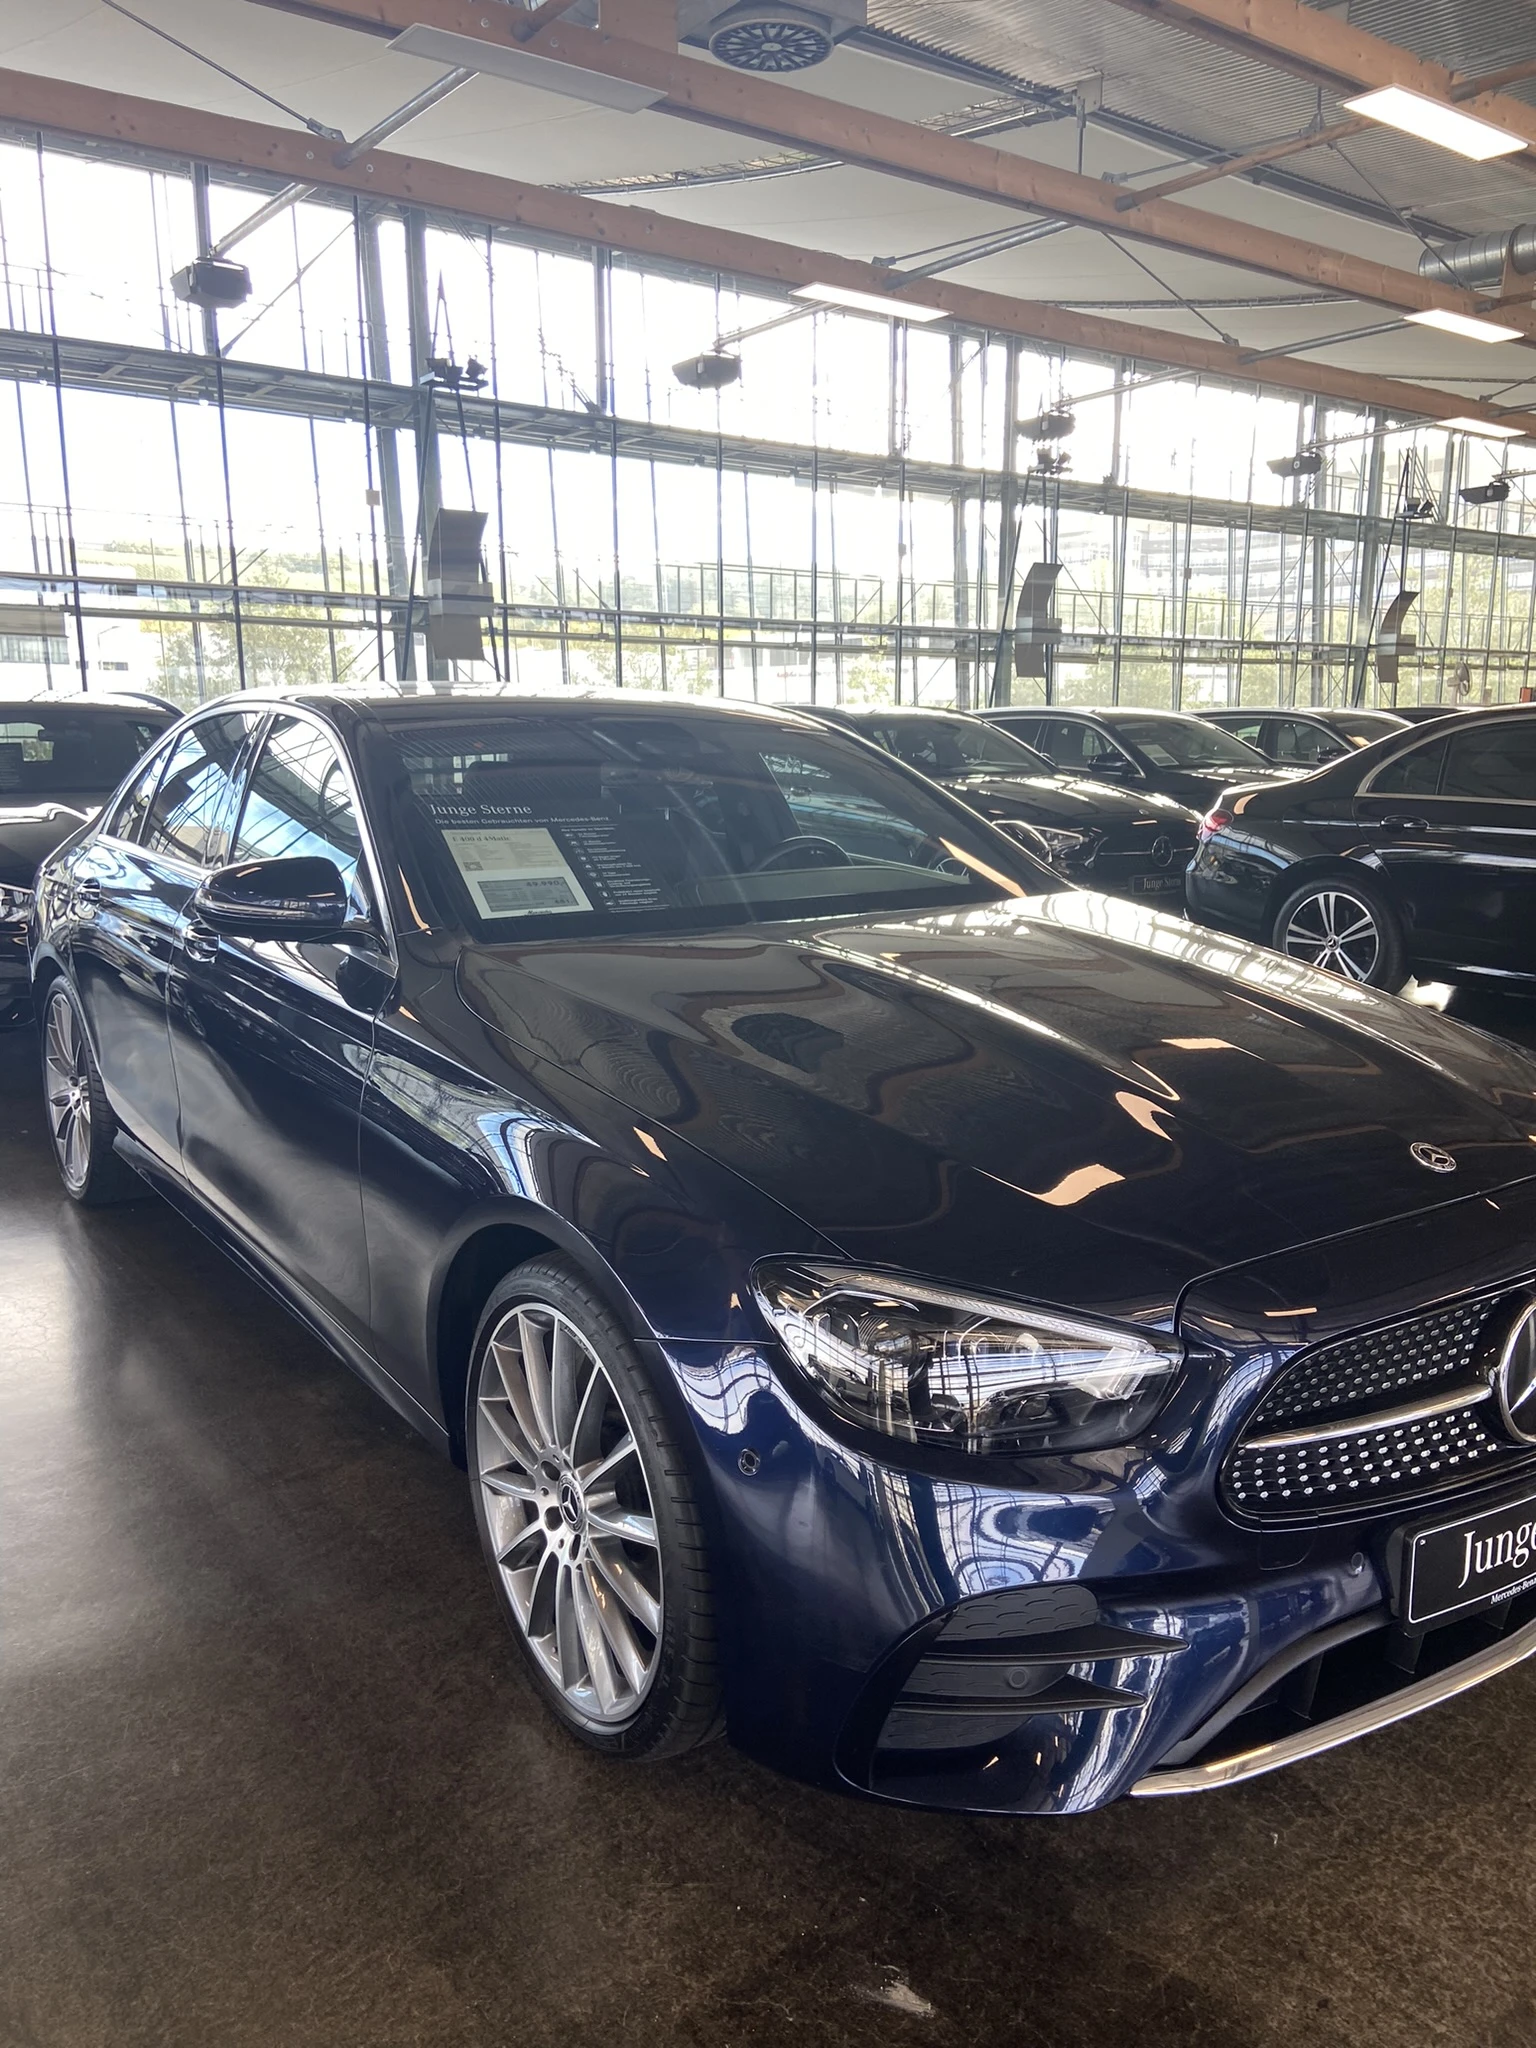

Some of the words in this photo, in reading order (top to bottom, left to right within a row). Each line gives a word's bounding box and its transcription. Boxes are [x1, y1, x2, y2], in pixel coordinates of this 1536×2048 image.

[430, 804, 477, 816] Junge
[480, 804, 532, 815] Sterne
[1143, 878, 1163, 890] Junge
